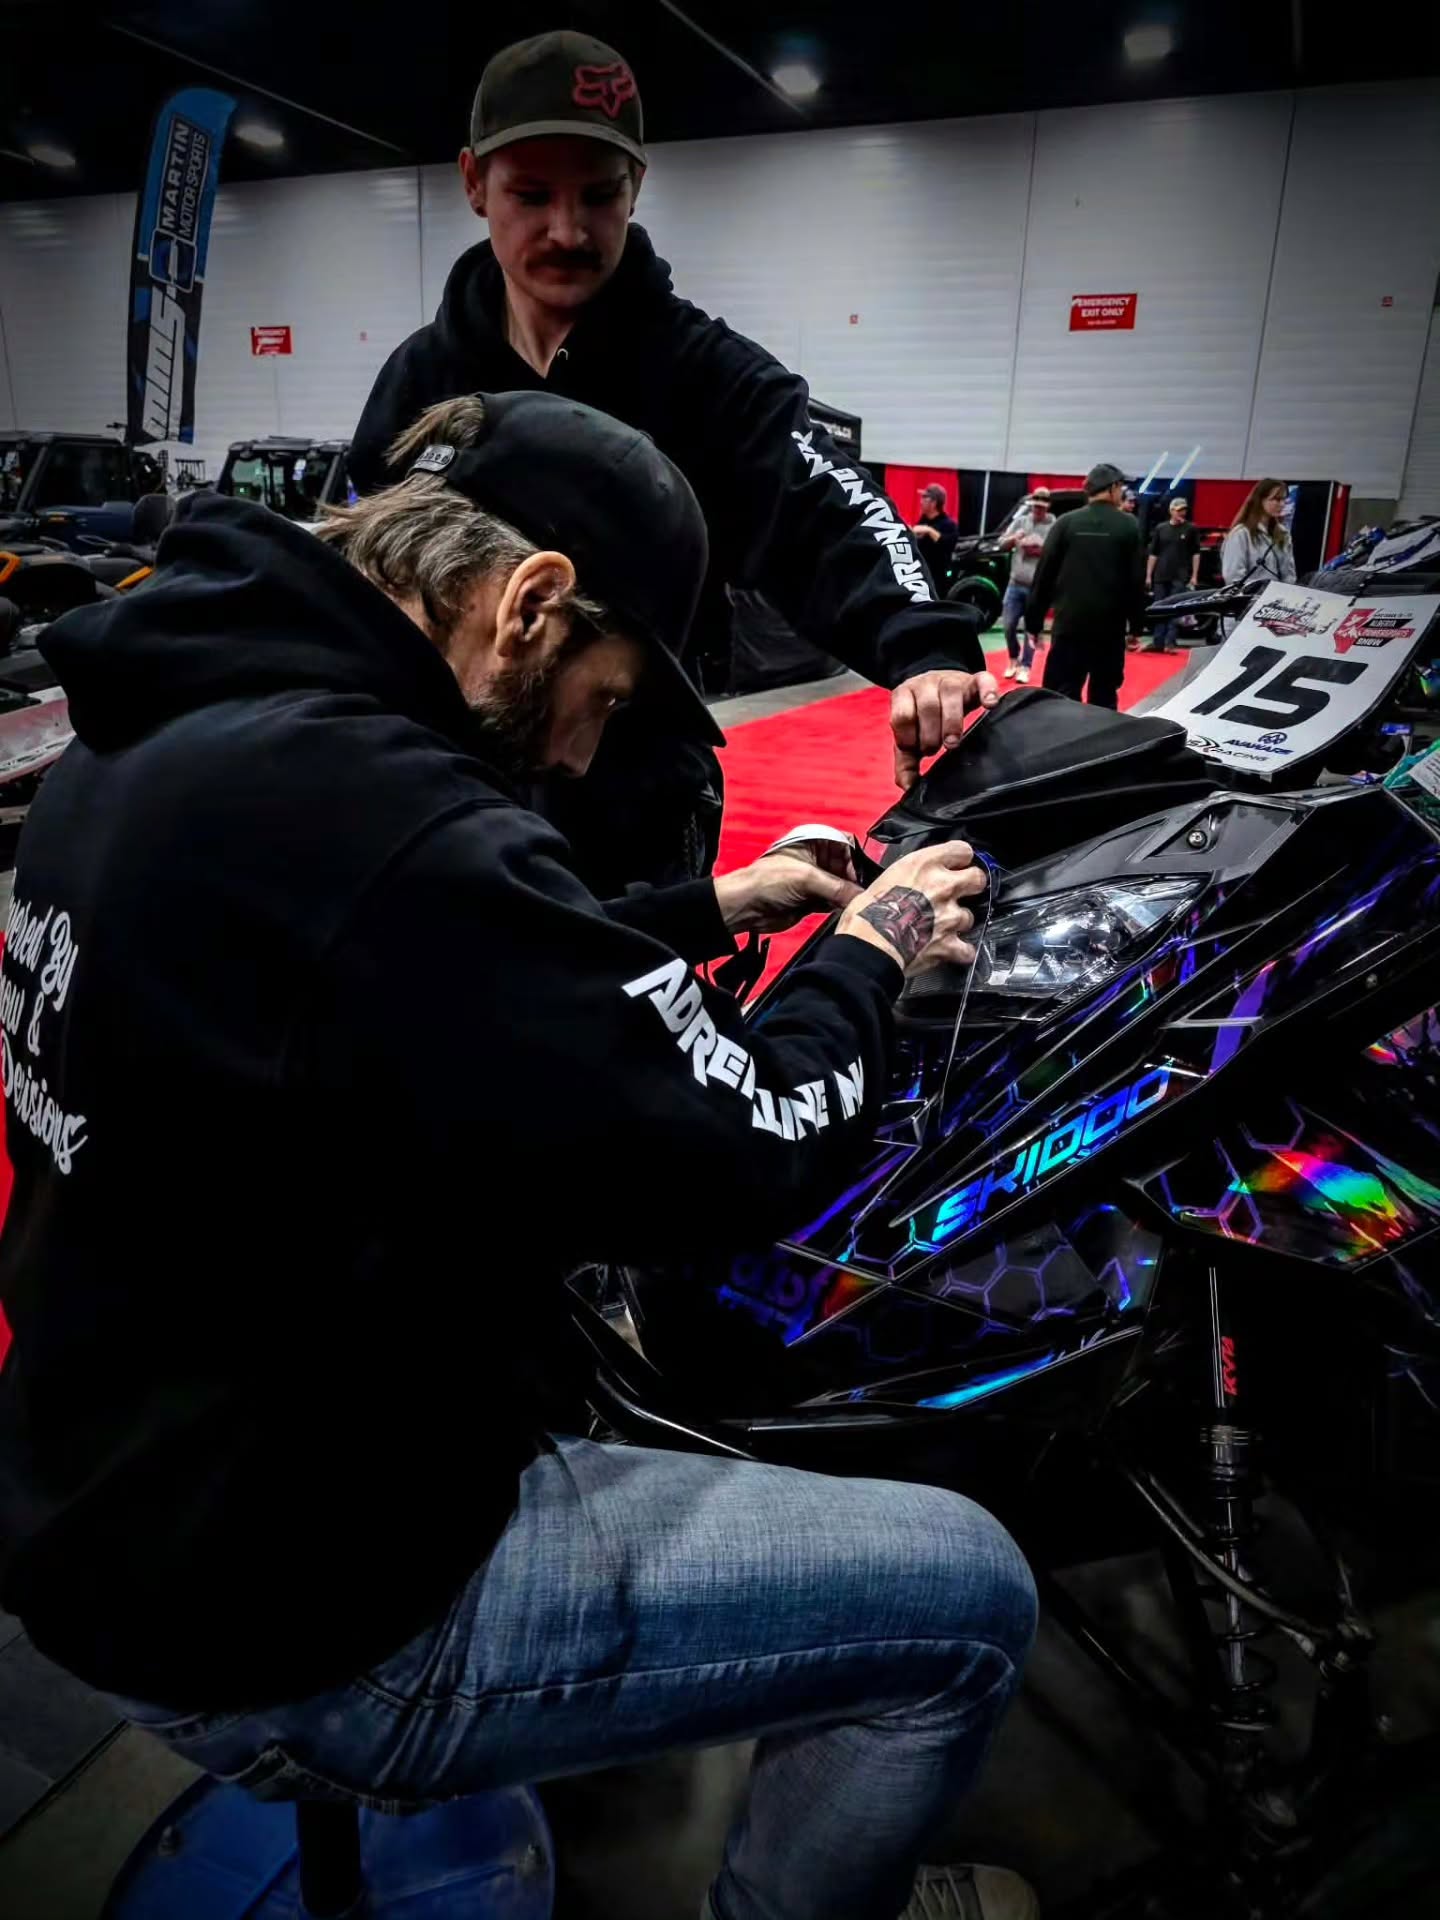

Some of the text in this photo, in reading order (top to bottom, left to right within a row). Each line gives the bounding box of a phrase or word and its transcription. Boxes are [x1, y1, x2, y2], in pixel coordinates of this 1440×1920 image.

[162, 122, 190, 229] MARTIN
[178, 132, 206, 238] MOTORSPORTS
[1077, 297, 1130, 307] EMERGENCY
[1081, 307, 1125, 318] EXIT ONLY
[1355, 637, 1384, 647] SHOW
[1190, 645, 1369, 730] 15
[40, 911, 79, 1012] By
